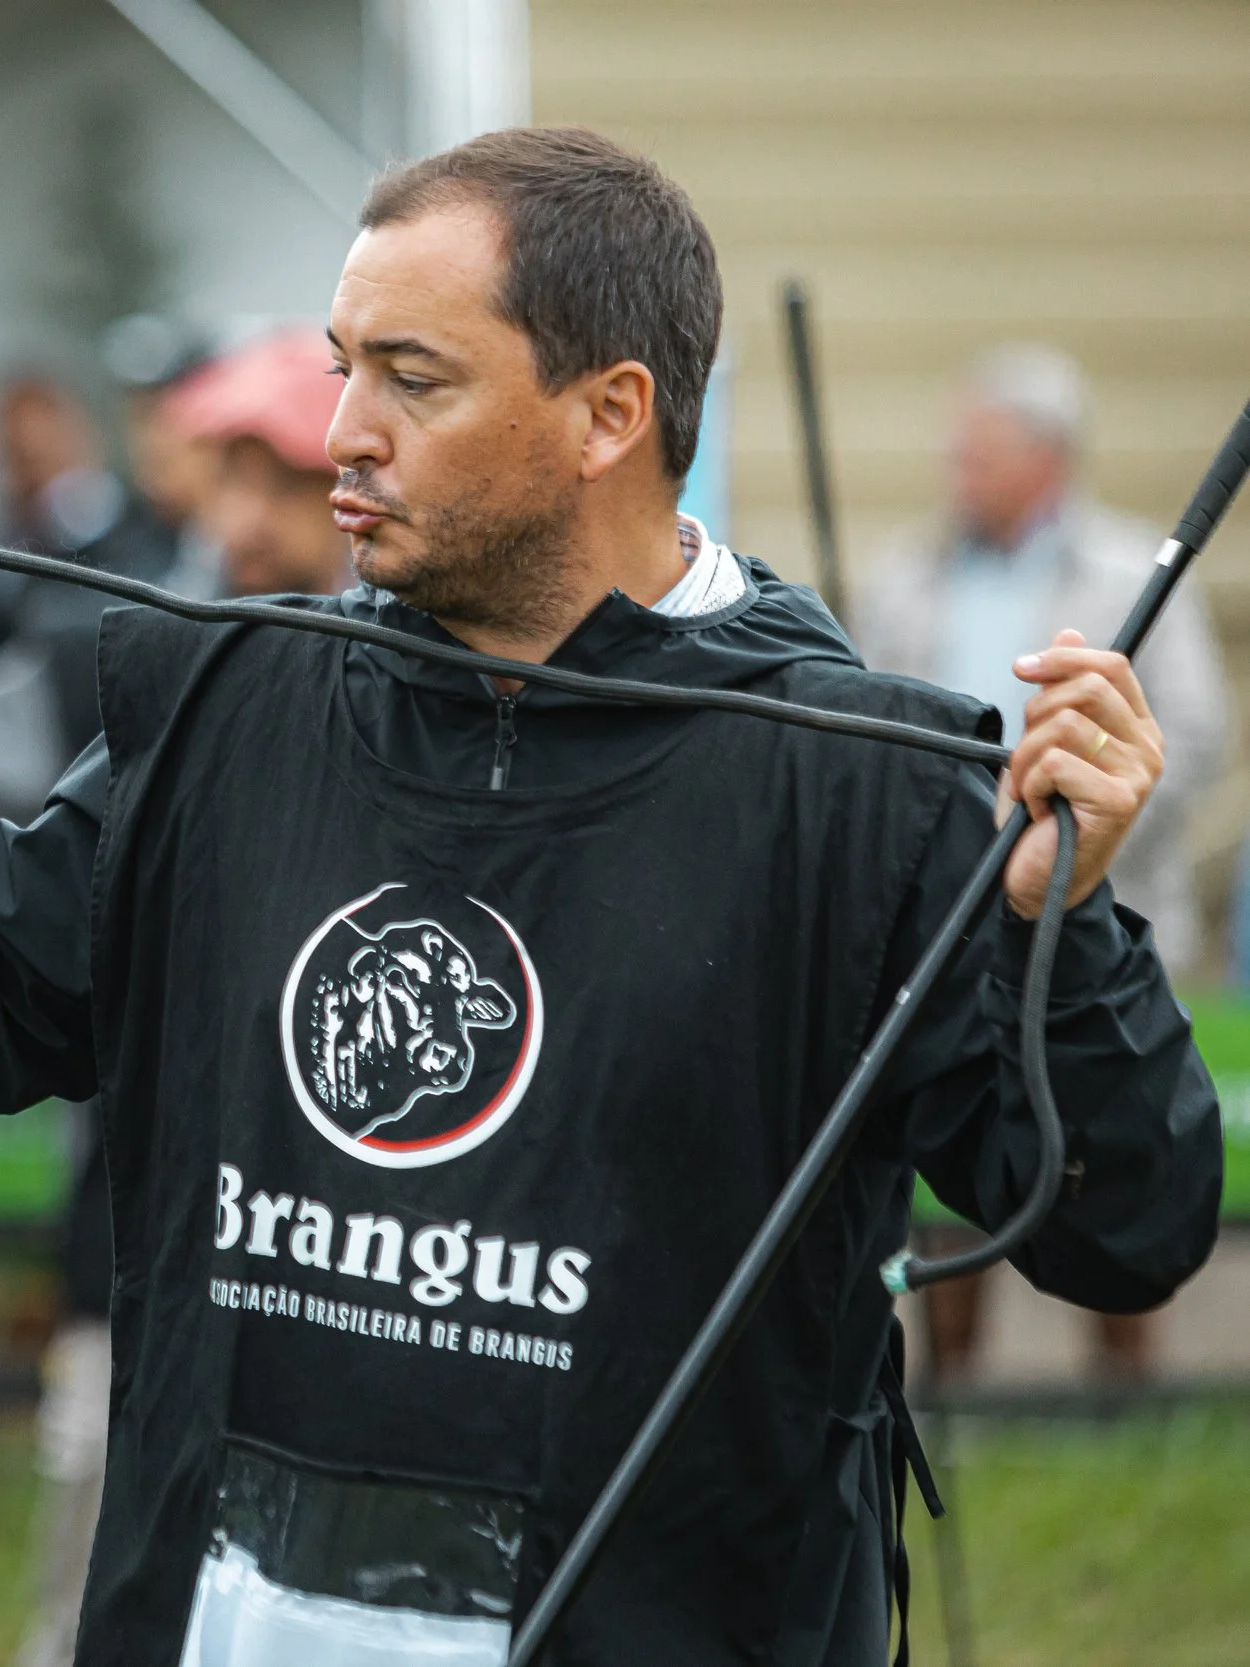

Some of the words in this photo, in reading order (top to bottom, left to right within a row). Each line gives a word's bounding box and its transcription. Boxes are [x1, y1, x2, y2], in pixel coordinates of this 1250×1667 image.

[213, 1161, 592, 1314] Brangus
[305, 1293, 422, 1345] BRASILEIRA
[430, 1319, 462, 1352] DE
[468, 1325, 574, 1371] BRANGUS
